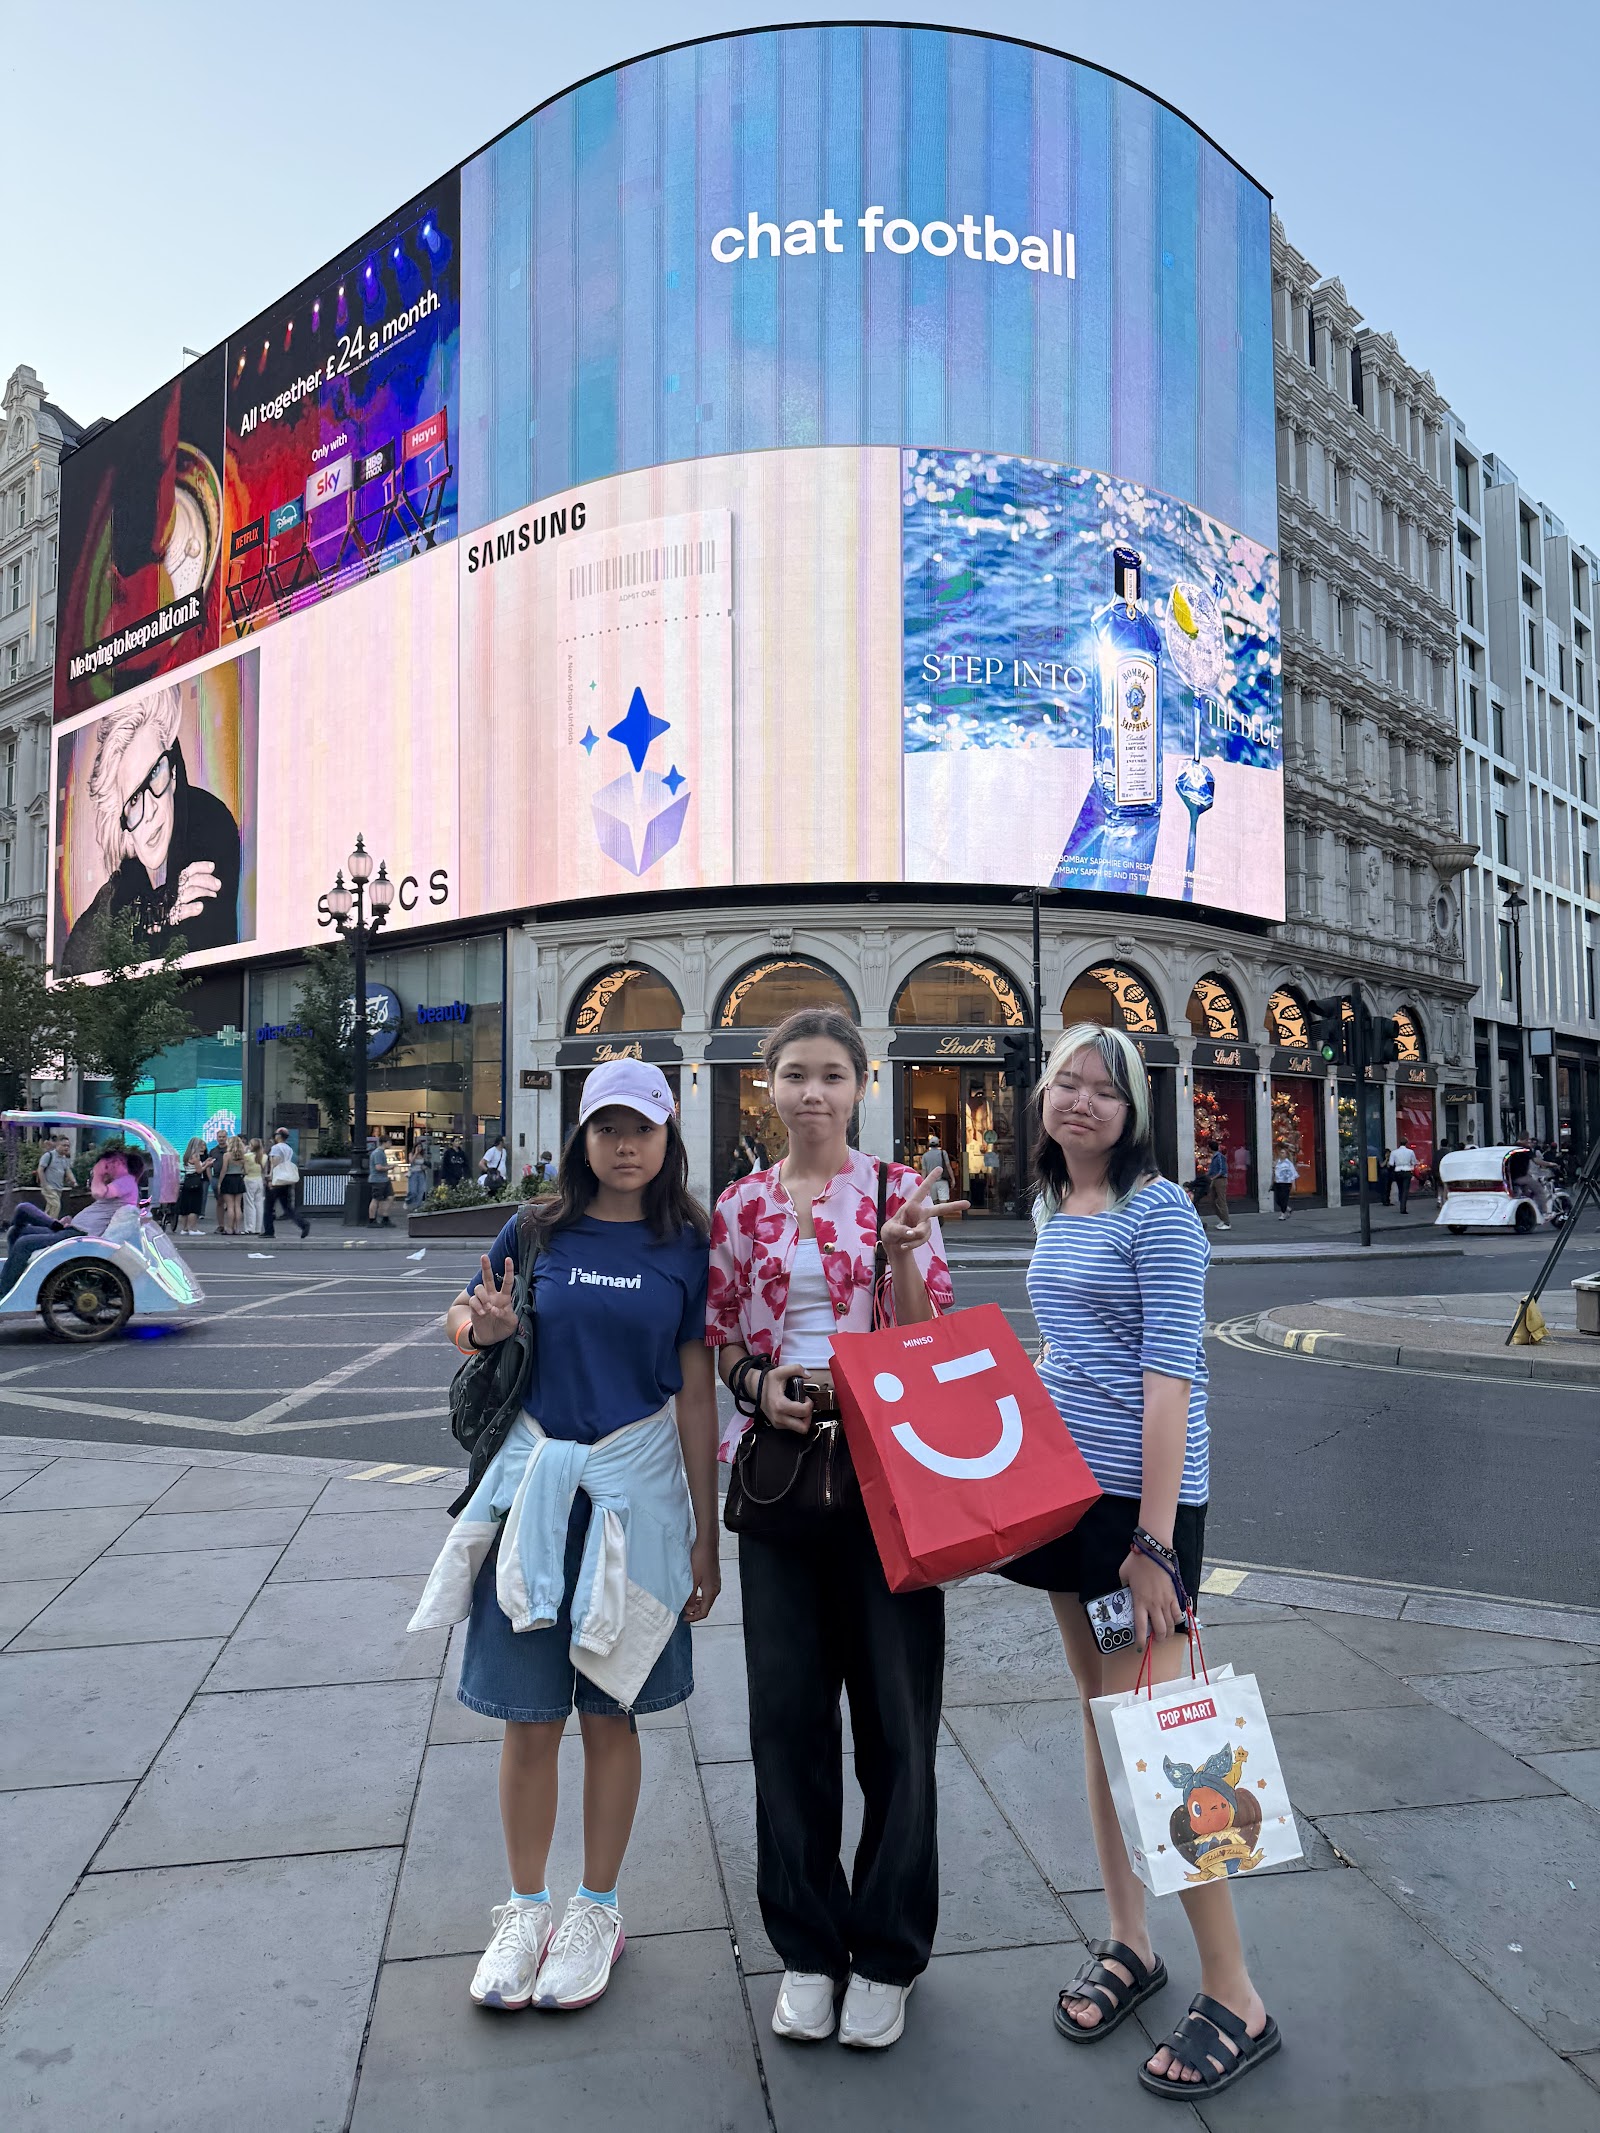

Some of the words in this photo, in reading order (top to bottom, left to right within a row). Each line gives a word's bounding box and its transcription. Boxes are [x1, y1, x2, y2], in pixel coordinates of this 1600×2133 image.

[711, 208, 843, 263] chat
[858, 206, 1076, 279] football
[240, 407, 258, 437] All
[260, 368, 322, 419] together.
[326, 325, 365, 381] £24
[369, 331, 379, 351] a
[382, 290, 441, 344] month.
[311, 444, 330, 462] Only
[330, 432, 348, 452] with
[412, 424, 437, 447] Hayu
[365, 452, 384, 471] HBO
[365, 464, 383, 480] max
[316, 468, 341, 497] sky
[235, 526, 259, 551] NETFLIX
[468, 502, 586, 574] SAMSUNG
[619, 591, 640, 602] ADMIT
[641, 589, 657, 598] ONE
[69, 656, 85, 680] Me
[85, 645, 113, 673] trying
[113, 638, 125, 657] to
[125, 625, 151, 651] keep
[151, 621, 159, 639] a
[159, 607, 173, 635] lid
[174, 605, 189, 626] on
[921, 654, 1004, 685] STEP
[1013, 660, 1087, 694] INTO
[1205, 699, 1237, 734] THE
[1240, 713, 1279, 749] BLUE
[1048, 865, 1079, 875] BOMBAY
[1080, 868, 1112, 879] SAPPHRE
[1113, 871, 1128, 879] AND
[1128, 873, 1138, 881] ITS
[1059, 855, 1088, 864] BOMBAY
[1089, 857, 1121, 868] SAPPHIRE
[1122, 861, 1135, 869] GIN
[317, 869, 449, 927] SCS
[417, 1000, 470, 1025] beauty
[935, 1036, 985, 1055] Lindt
[1213, 1049, 1235, 1066] Lindt
[568, 1267, 642, 1289] j'aimavi
[903, 1335, 934, 1348] MINISO
[1159, 1709, 1181, 1728] POP
[1181, 1701, 1212, 1722] MART
